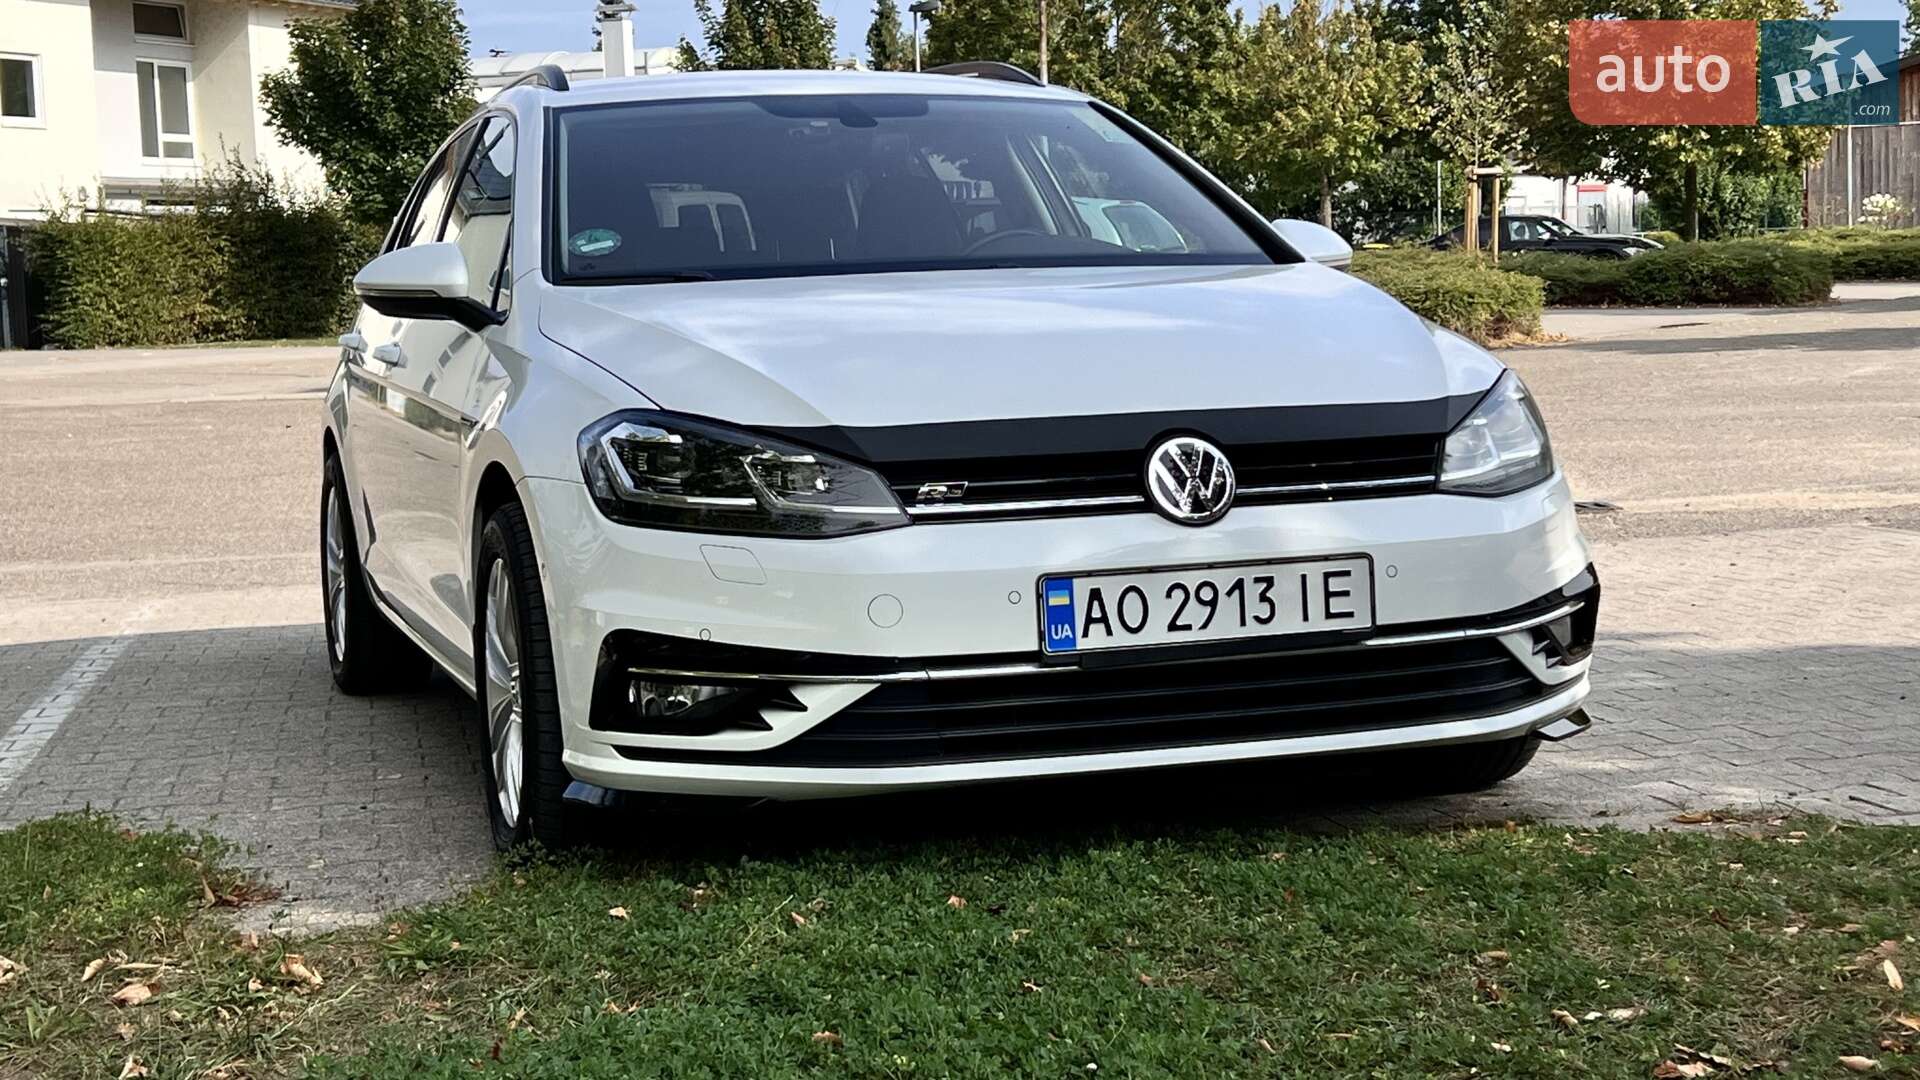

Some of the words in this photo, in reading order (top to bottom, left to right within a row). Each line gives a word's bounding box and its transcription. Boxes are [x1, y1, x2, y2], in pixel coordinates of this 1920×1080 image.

[1081, 585, 1149, 638] AO
[1165, 575, 1276, 632] 2913
[1300, 569, 1355, 622] IE
[1051, 623, 1074, 640] UA
